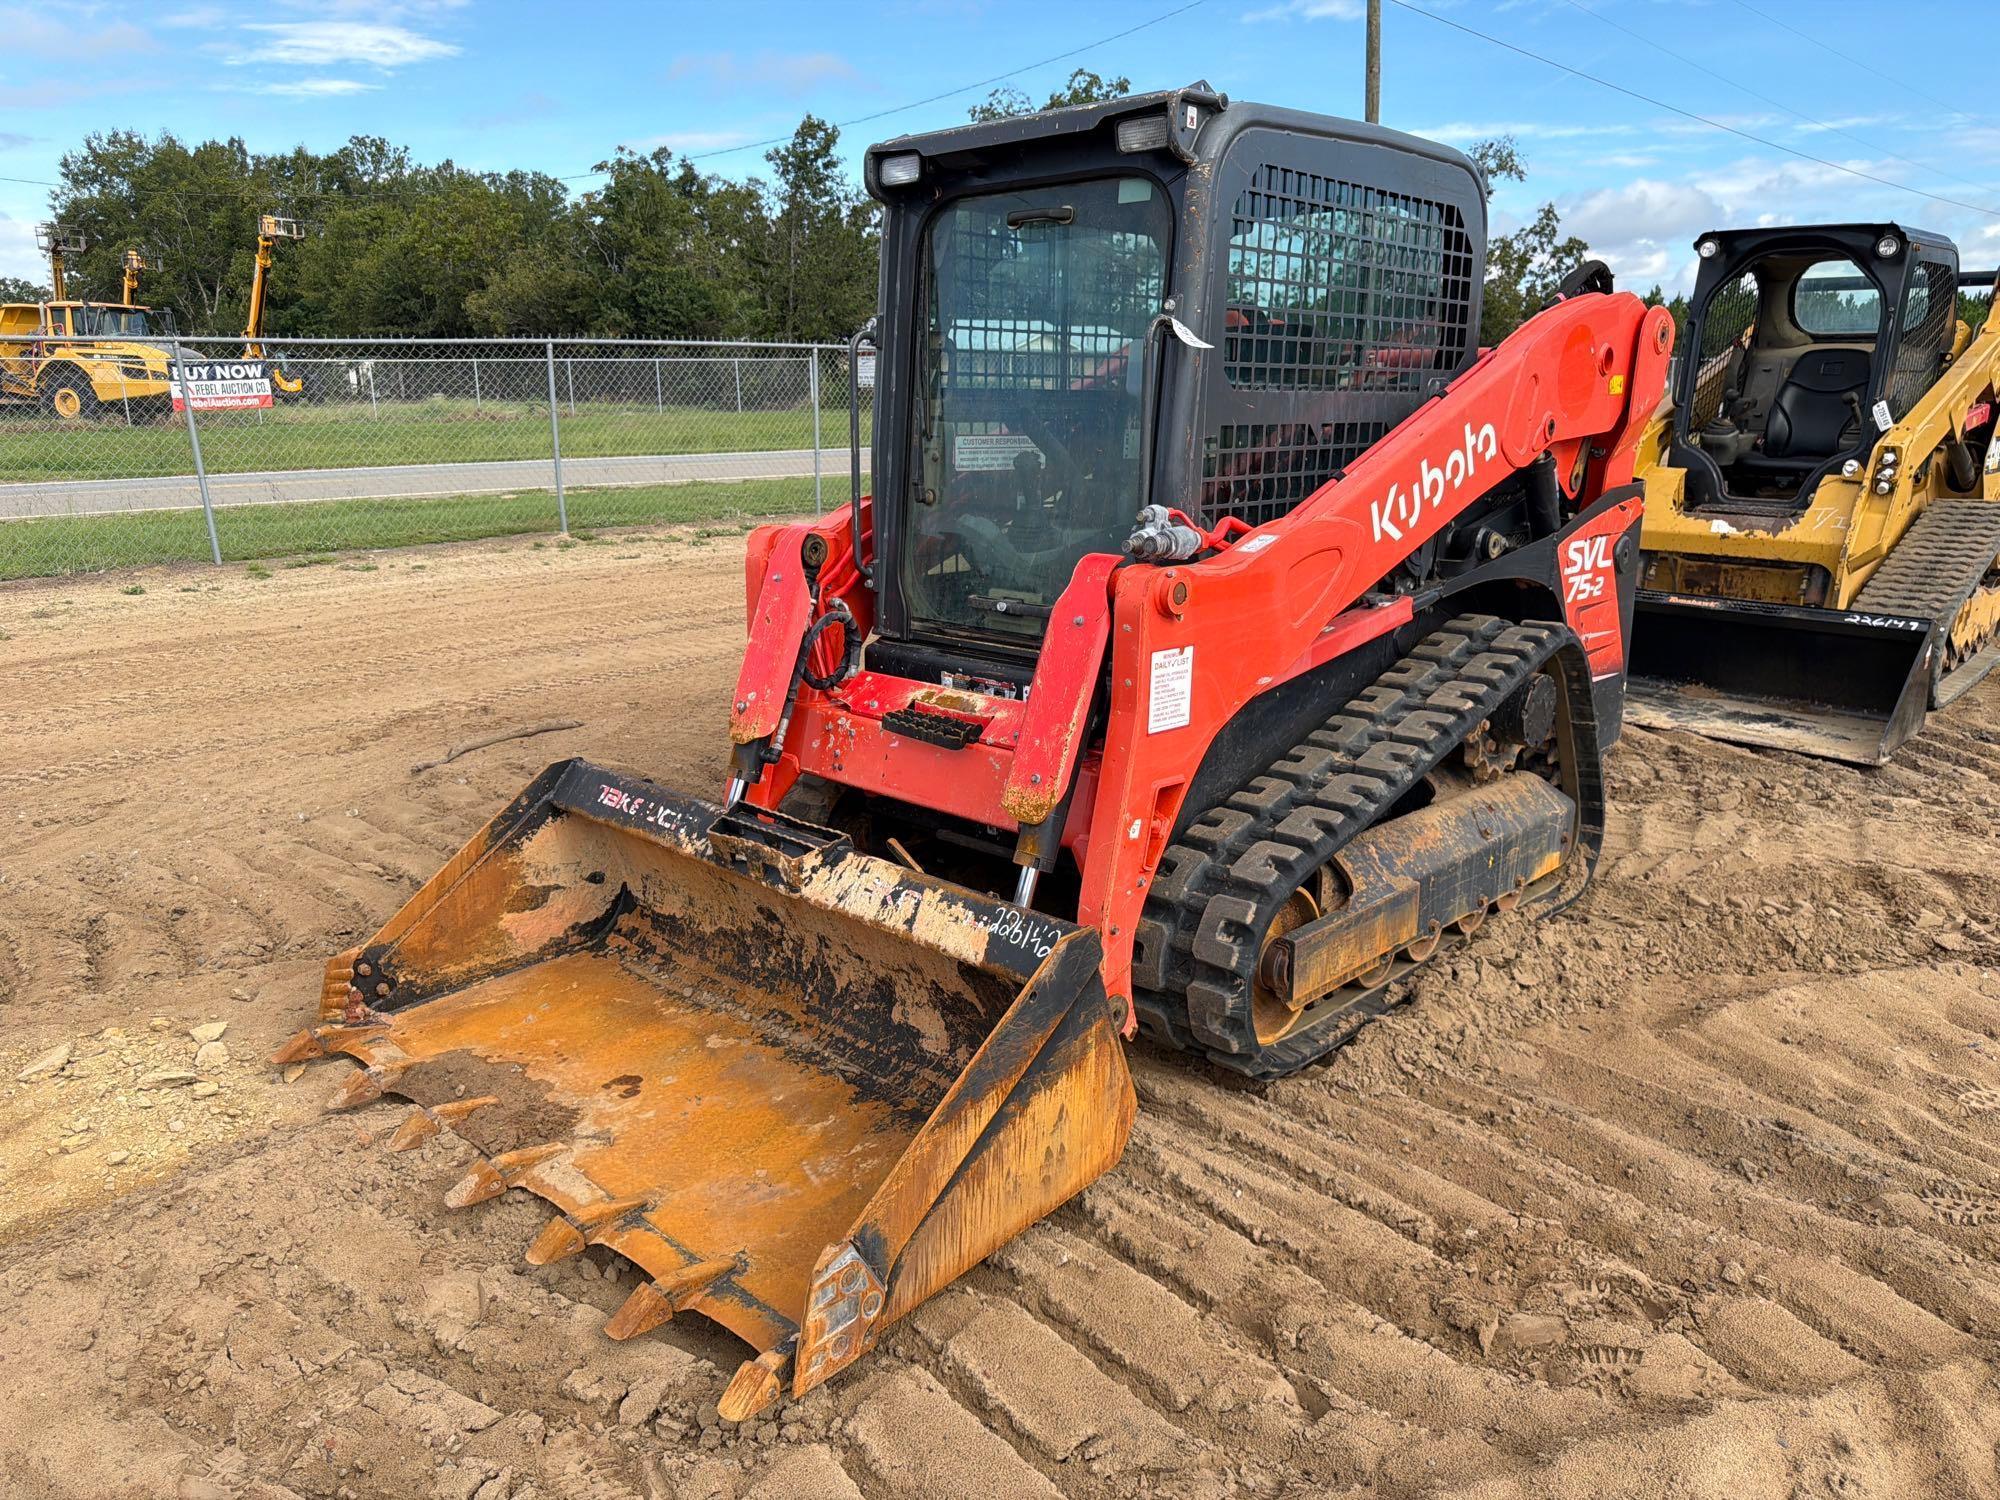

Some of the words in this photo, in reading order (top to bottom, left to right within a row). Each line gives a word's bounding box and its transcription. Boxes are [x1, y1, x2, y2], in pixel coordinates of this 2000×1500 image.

[215, 364, 262, 379] NOW
[195, 383, 219, 396] REBEL
[221, 382, 253, 395] AUCTION
[255, 381, 269, 393] CO.
[190, 397, 260, 408] ebelAuction.com
[962, 438, 994, 446] CUSTOMER
[1370, 422, 1497, 543] Kubota
[1563, 536, 1613, 575] SVL
[1566, 573, 1605, 604] 75-2
[1154, 661, 1171, 671] DAILY
[1176, 656, 1190, 666] LIST
